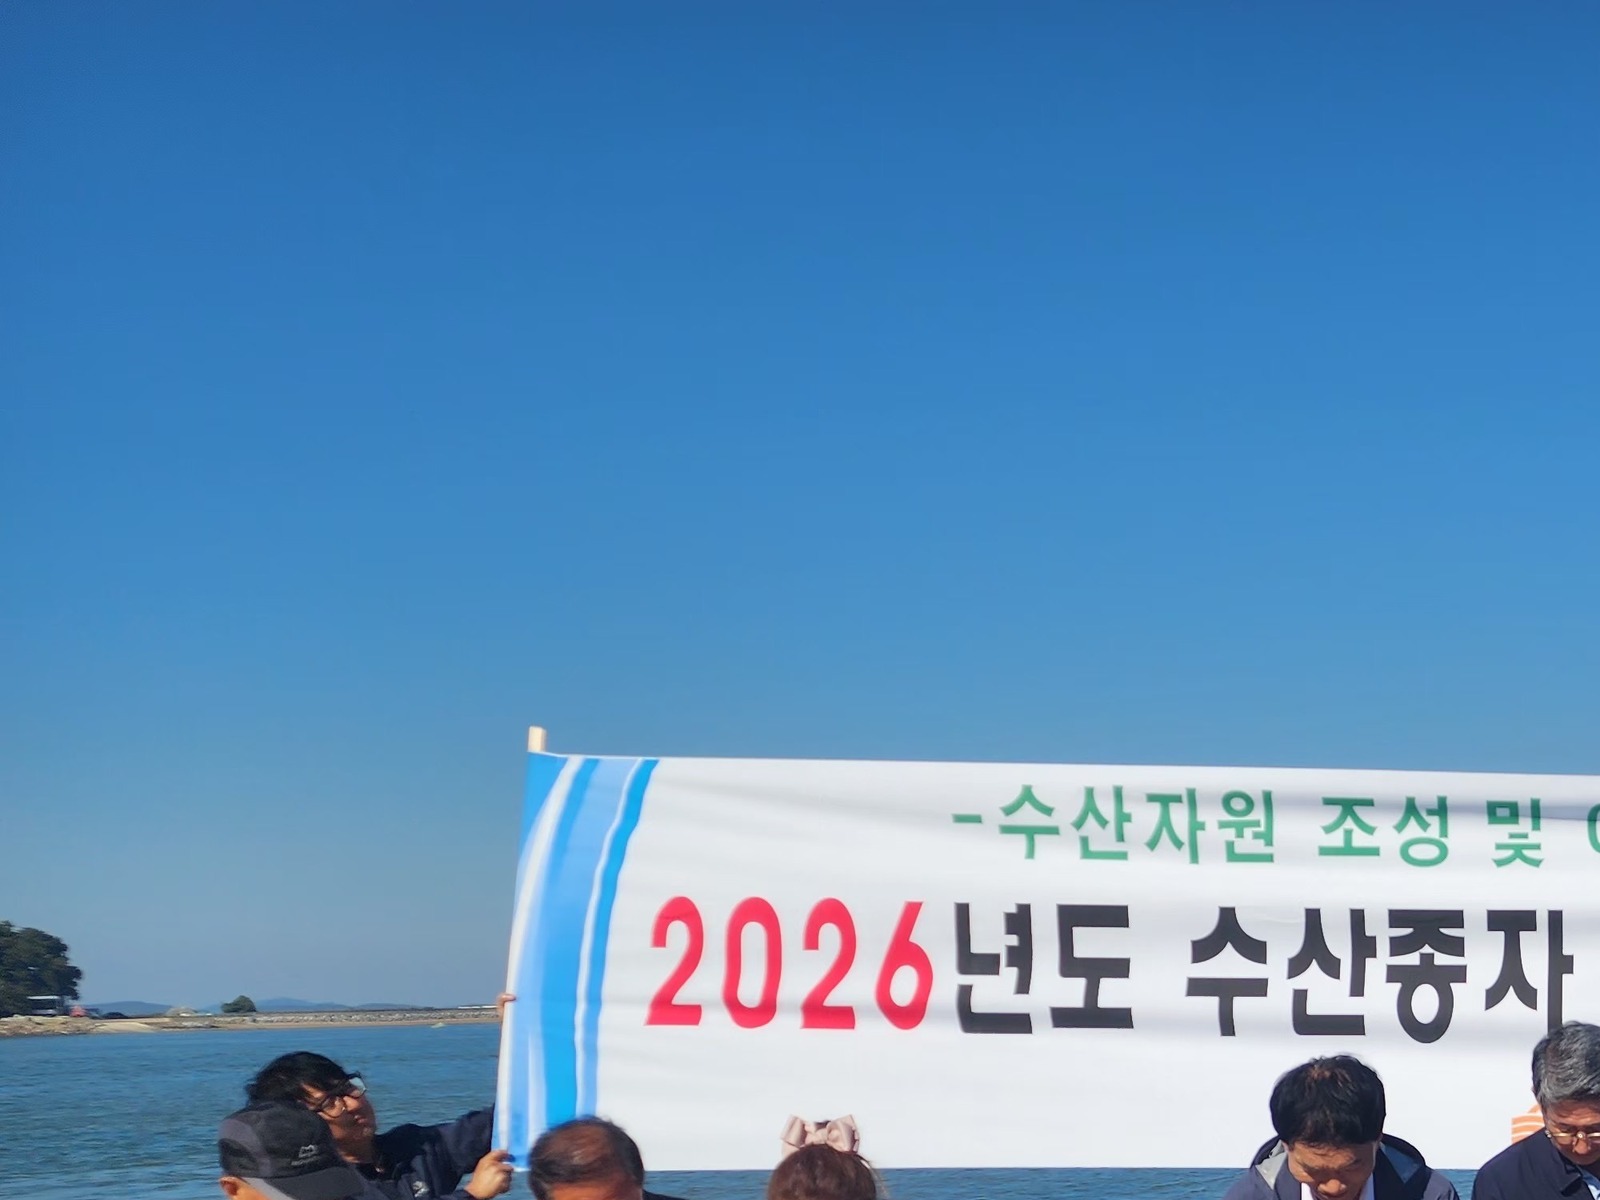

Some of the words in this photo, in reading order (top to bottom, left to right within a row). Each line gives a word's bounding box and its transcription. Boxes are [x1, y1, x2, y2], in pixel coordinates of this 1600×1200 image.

[1318, 795, 1451, 868] 조성
[1485, 797, 1544, 868] 및
[645, 896, 1134, 1036] 2026년도
[1186, 906, 1574, 1044] 수산종자
